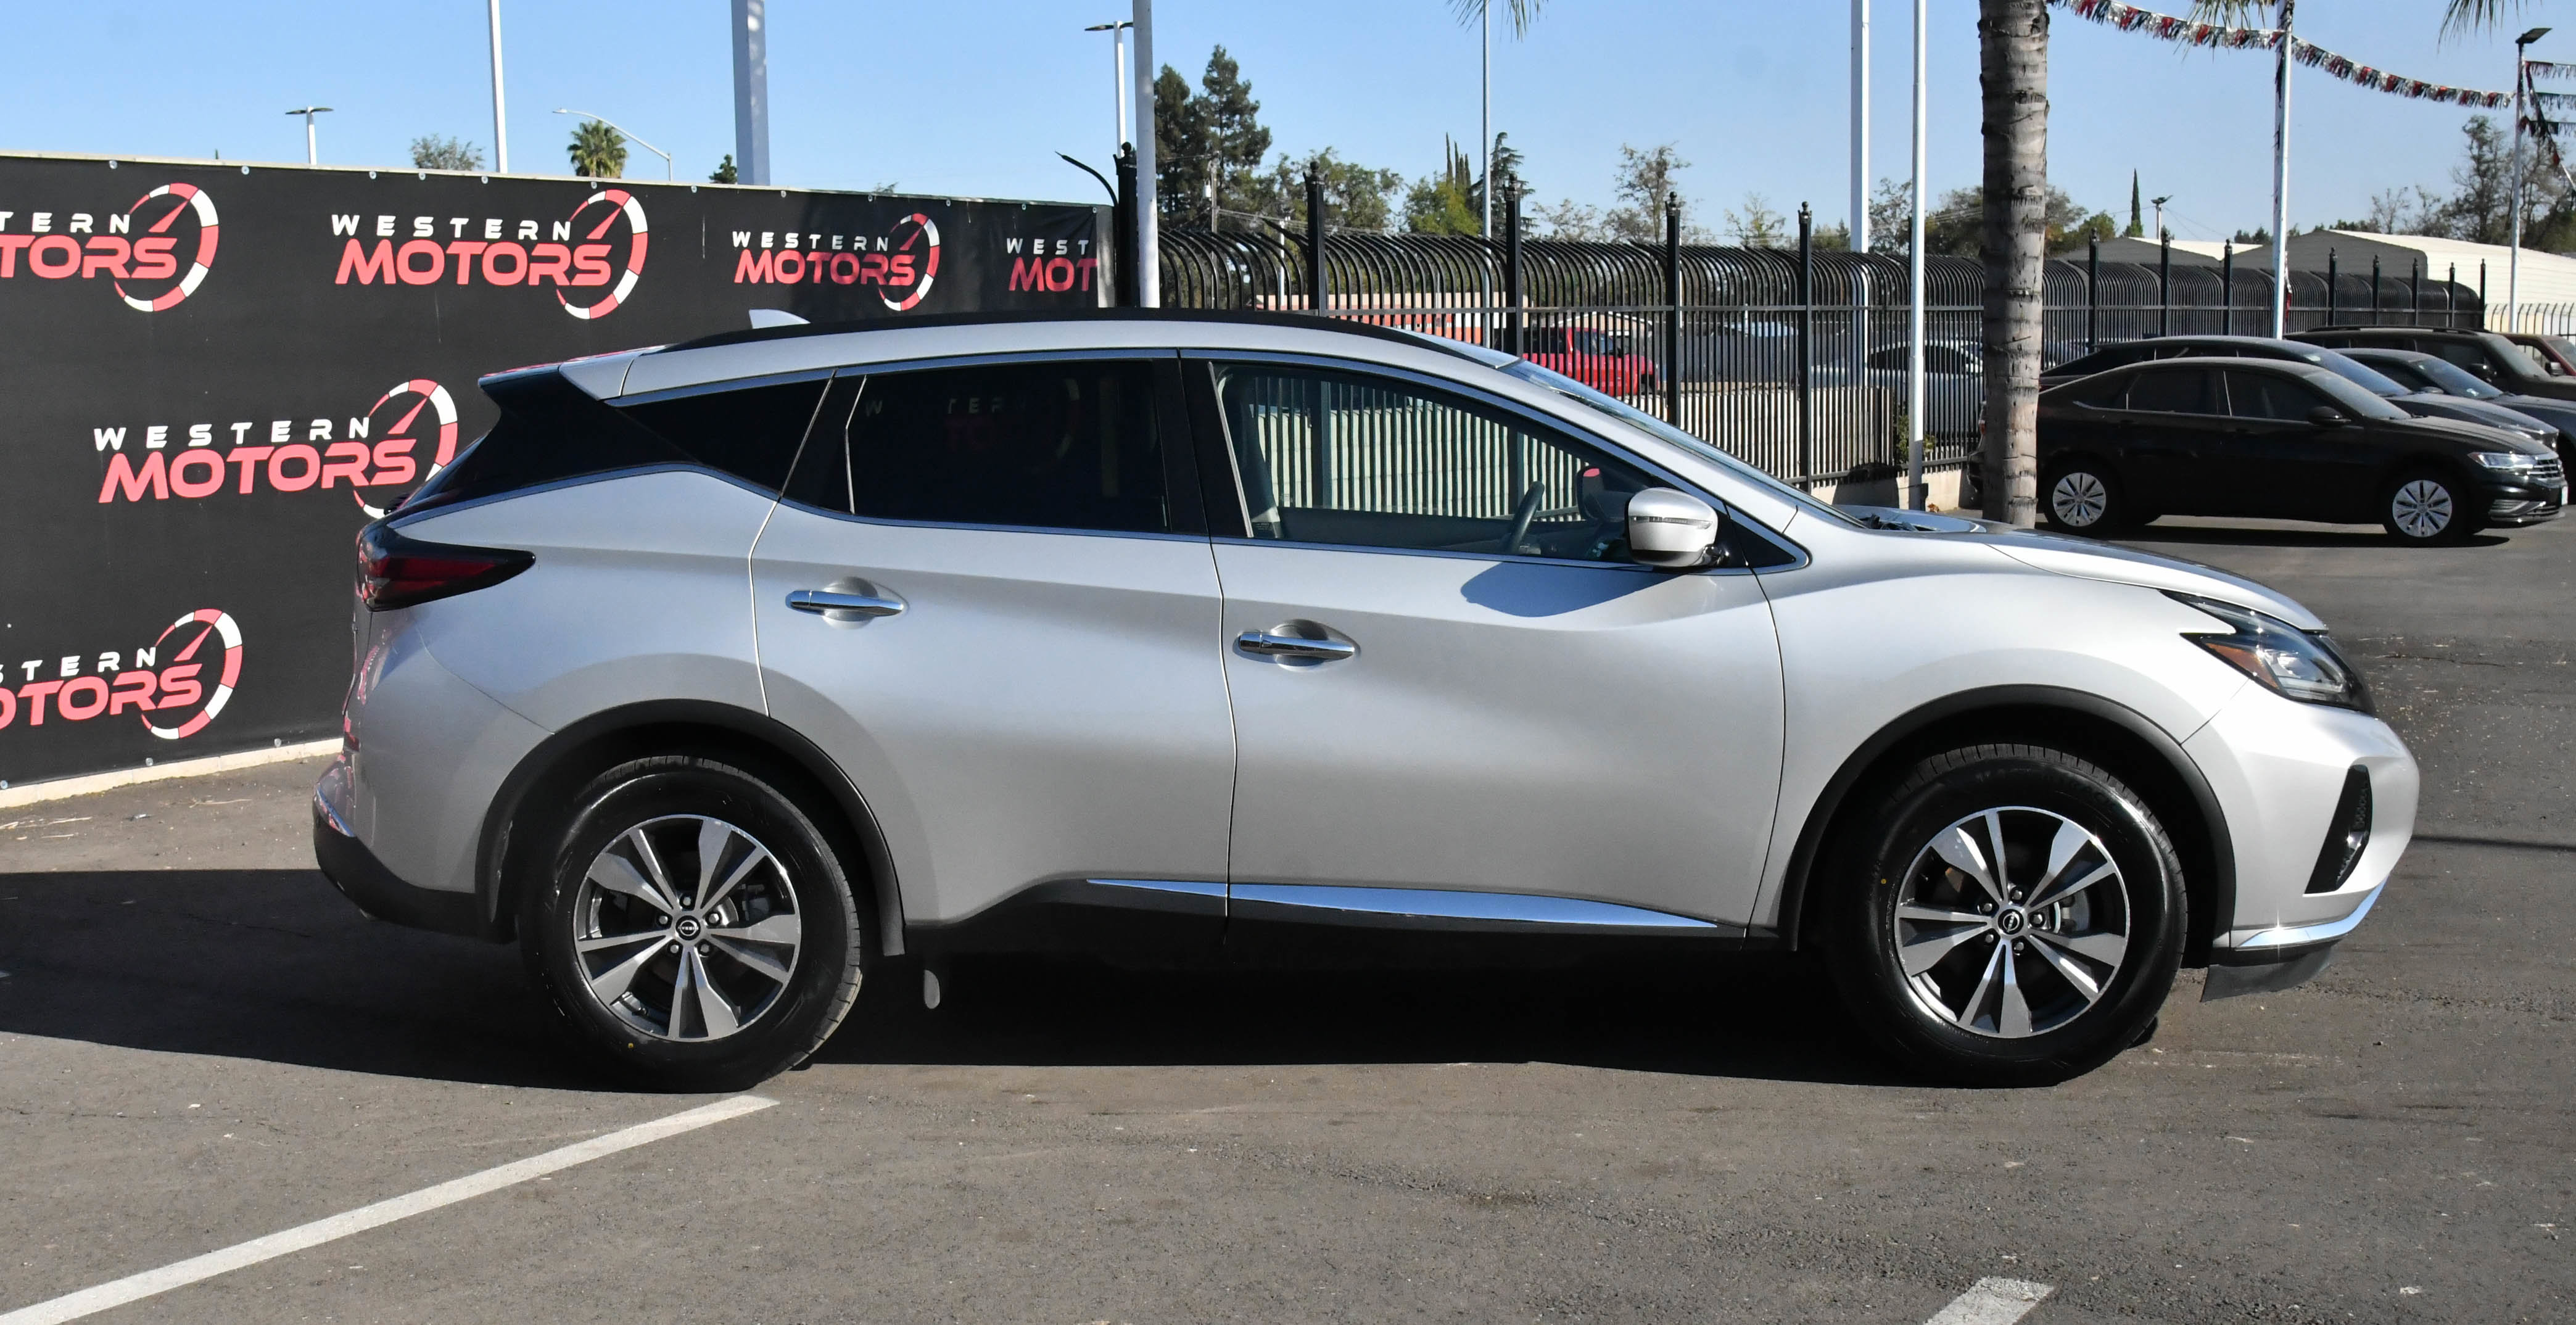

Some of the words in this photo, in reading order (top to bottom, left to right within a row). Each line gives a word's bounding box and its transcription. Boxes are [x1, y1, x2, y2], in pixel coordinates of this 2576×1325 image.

[332, 215, 571, 241] WESTERN
[732, 231, 888, 251] WESTERN
[335, 238, 611, 286] MOTORS
[1007, 237, 1089, 255] WEST
[734, 249, 915, 286] MOTORS
[1009, 257, 1099, 292] MOT
[94, 417, 369, 451] WESTERN
[99, 438, 416, 503] MOTORS
[0, 646, 156, 683] TERN
